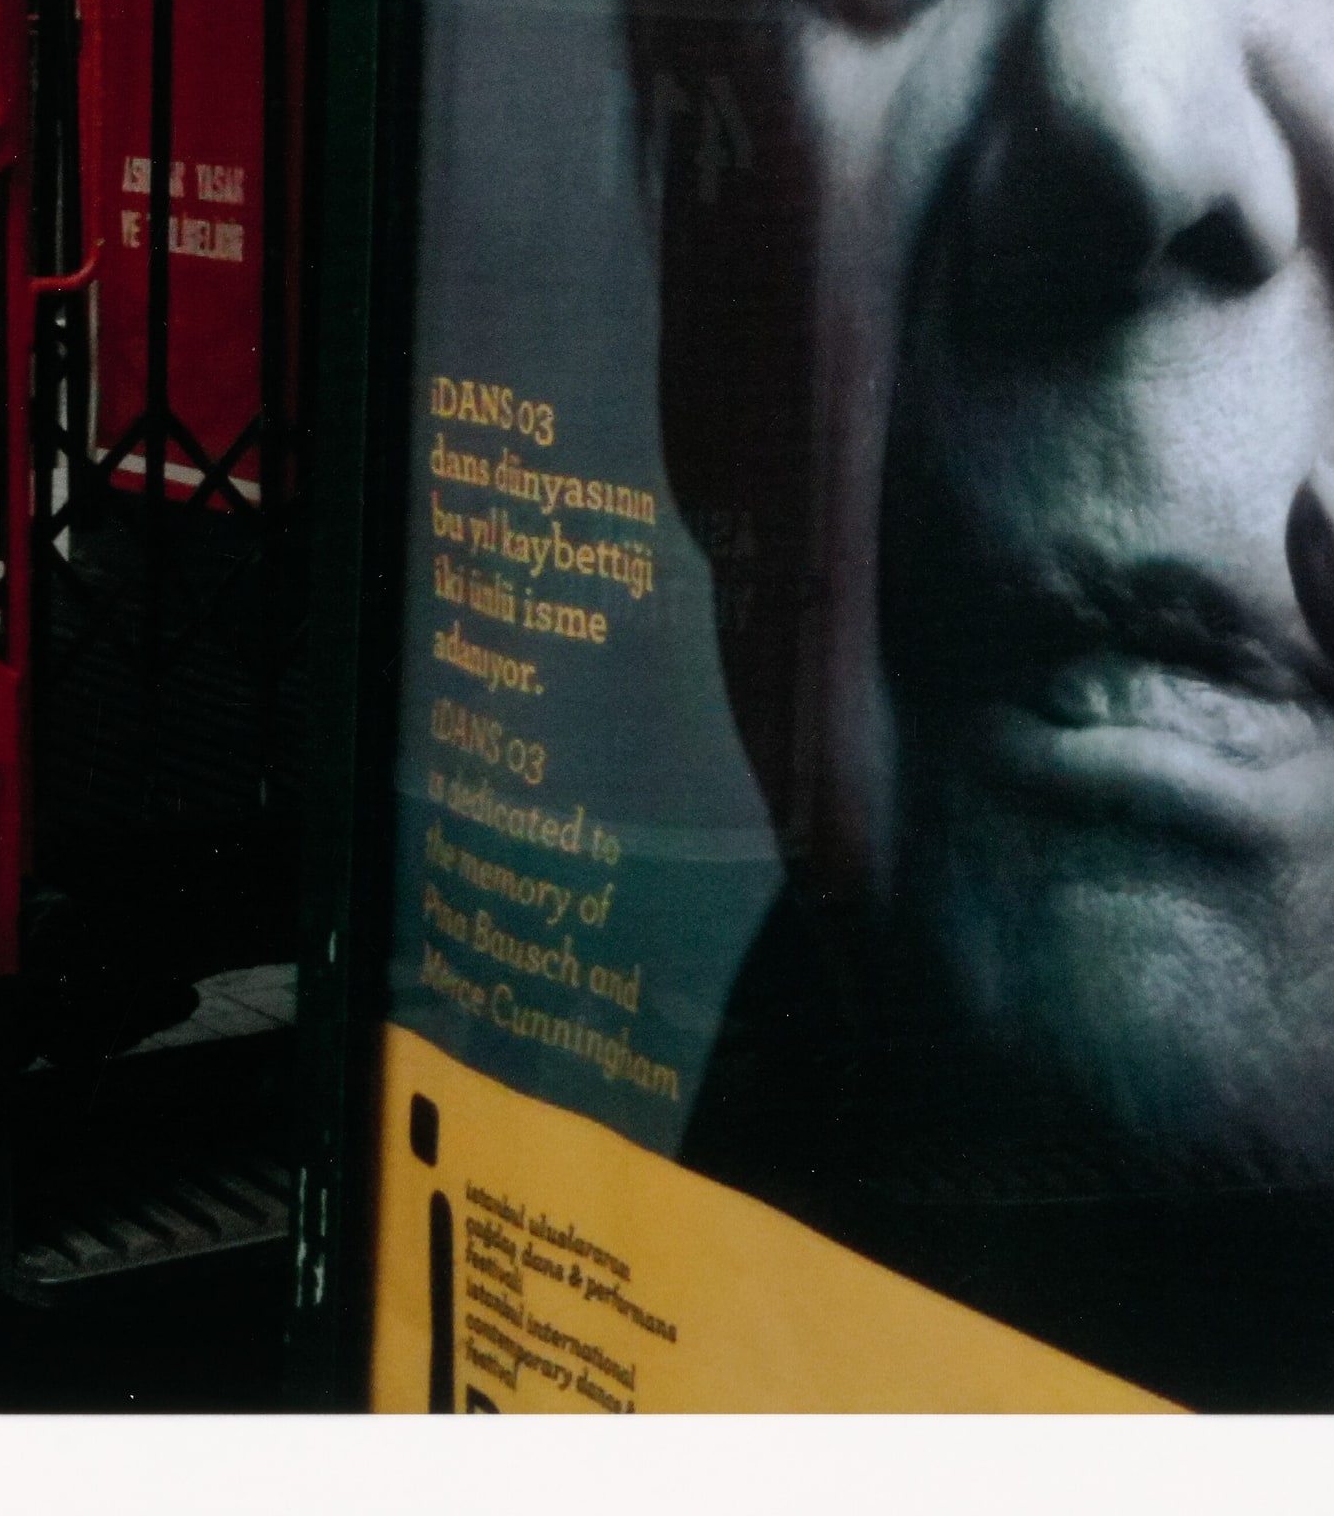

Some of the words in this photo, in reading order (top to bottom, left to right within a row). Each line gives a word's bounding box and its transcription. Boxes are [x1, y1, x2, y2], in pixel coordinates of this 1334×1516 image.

[518, 400, 555, 446] 03
[430, 433, 490, 486] dans
[431, 490, 465, 542] bu
[523, 588, 608, 644] isme
[507, 738, 546, 785] 03
[447, 776, 585, 853] dedicated
[592, 825, 621, 865] to
[458, 851, 573, 925] memory
[580, 882, 615, 928] of
[473, 909, 582, 989] Bausch
[589, 964, 641, 1014] and
[491, 983, 681, 1102] Cunningham
